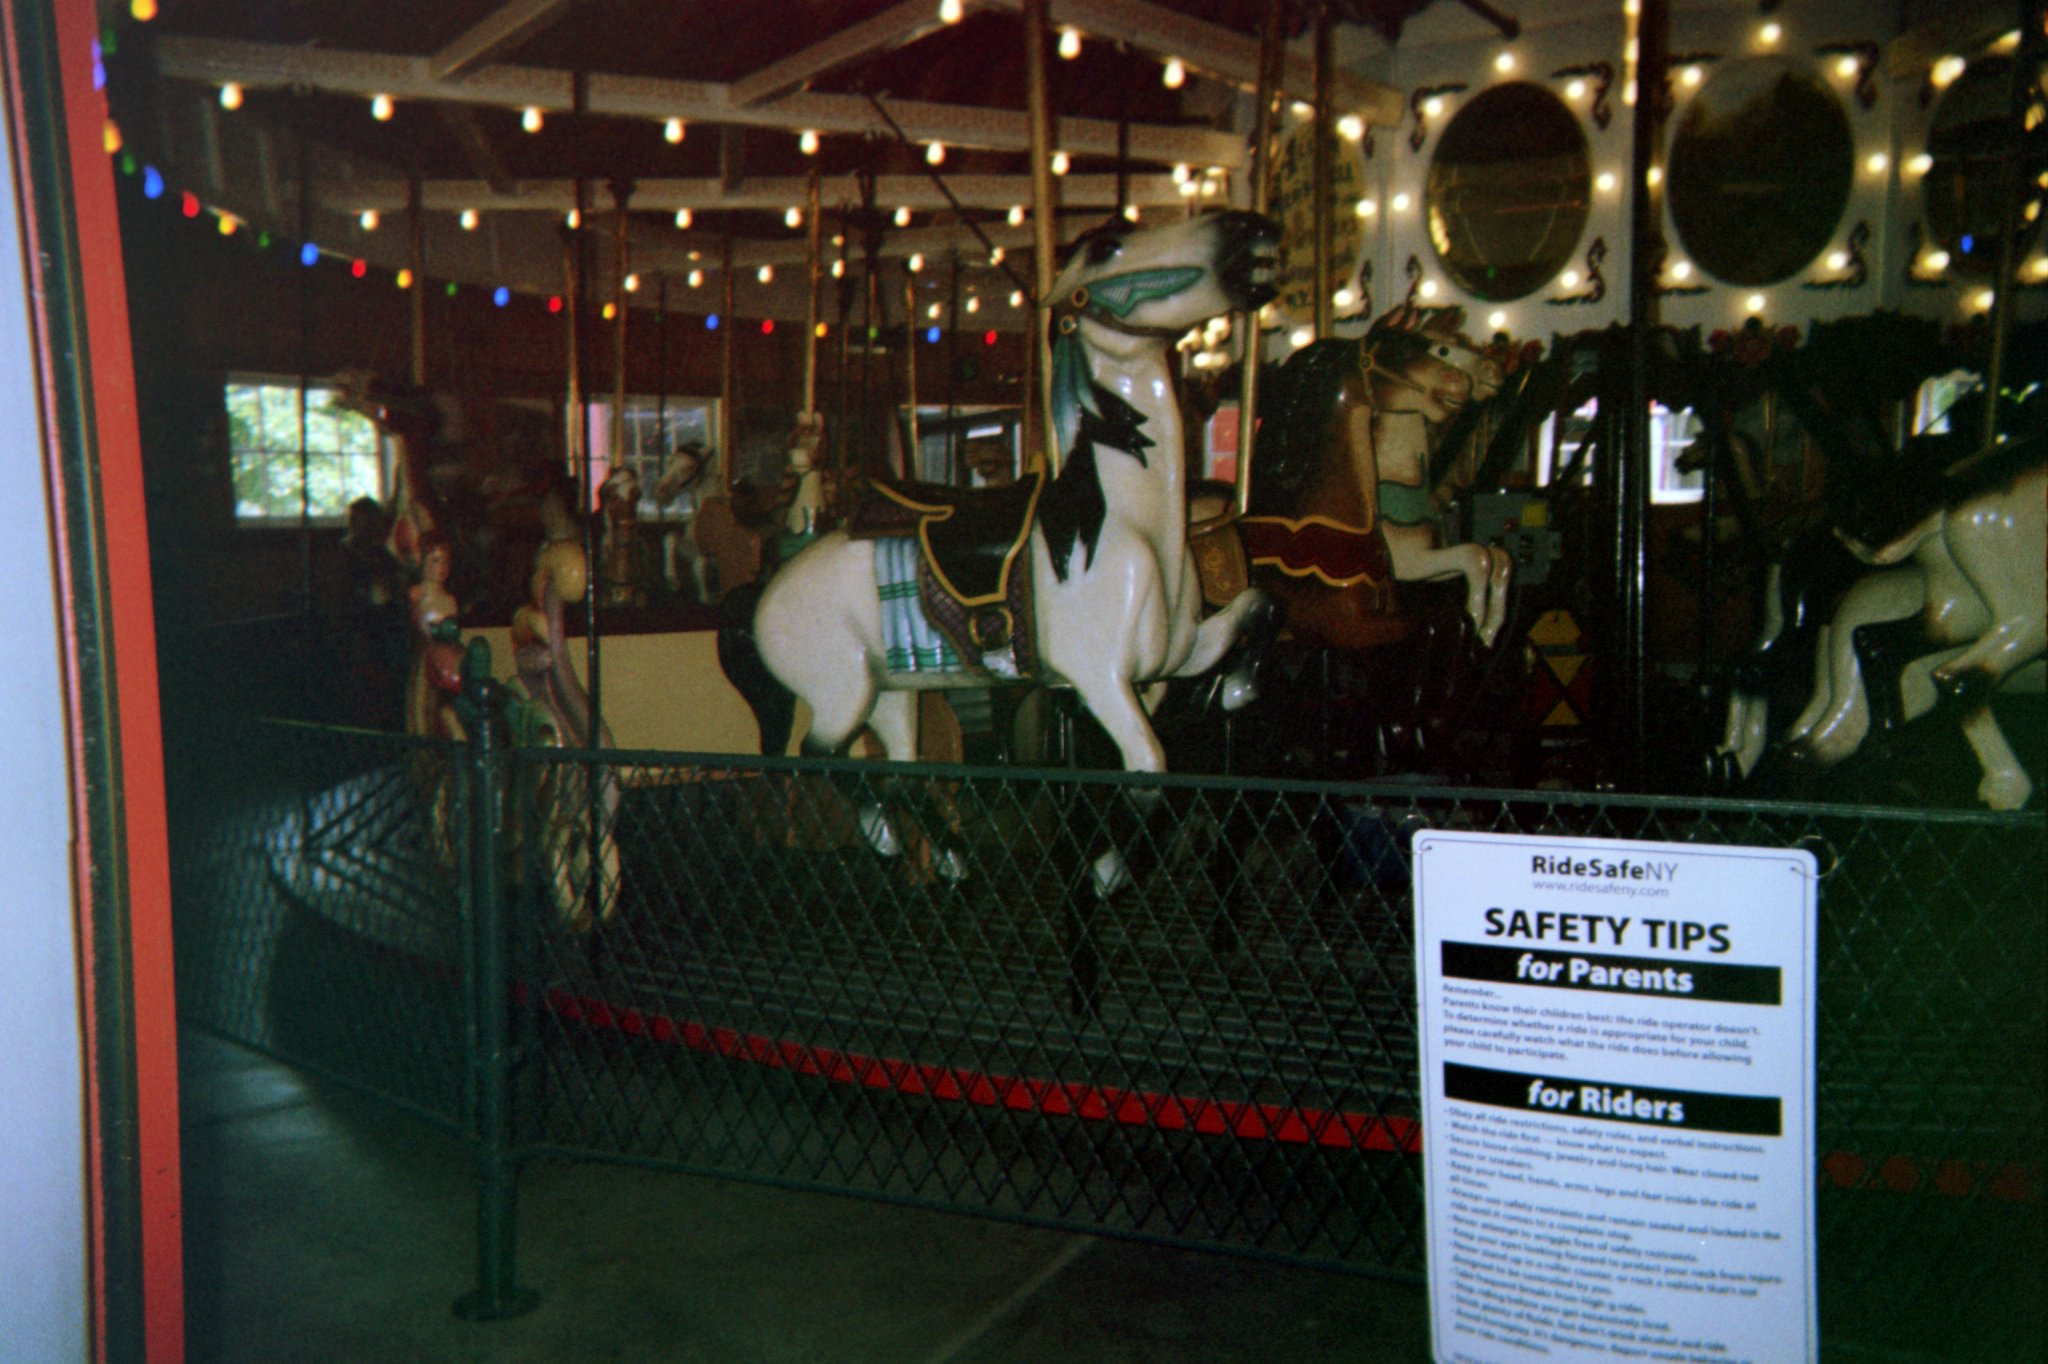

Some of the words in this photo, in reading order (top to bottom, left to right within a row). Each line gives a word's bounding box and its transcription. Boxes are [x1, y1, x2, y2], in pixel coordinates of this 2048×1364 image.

[1532, 855, 1679, 882] RideSafeNY
[1532, 879, 1670, 898] www.ridesafeny.com
[1485, 907, 1631, 946] SAFETY
[1642, 918, 1732, 954] TIPS
[1517, 953, 1564, 981] for
[1569, 957, 1695, 993] Parents
[1442, 996, 1479, 1009] Parents
[1482, 1001, 1509, 1012] know
[1512, 1004, 1537, 1015] their
[1540, 1007, 1583, 1019] children
[1616, 1013, 1634, 1024] the
[1637, 1015, 1658, 1026] ride
[1661, 1018, 1711, 1033] operator
[1714, 1022, 1759, 1035] doesn't.
[1443, 1009, 1454, 1018] To
[1456, 1010, 1507, 1025] determine
[1511, 1017, 1554, 1030] whether
[1566, 1023, 1587, 1033] ride
[1590, 1025, 1598, 1034] is
[1601, 1026, 1667, 1043] appropriate
[1670, 1032, 1685, 1042] for
[1689, 1036, 1714, 1047] your
[1443, 1023, 1473, 1037] please
[1476, 1027, 1520, 1042] carefully
[1524, 1032, 1554, 1044] watch
[1558, 1036, 1584, 1047] what
[1587, 1039, 1603, 1049] the
[1607, 1041, 1627, 1051] ride
[1632, 1043, 1658, 1055] does
[1662, 1046, 1698, 1058] before
[1701, 1050, 1751, 1065] allowing
[1443, 1038, 1464, 1049] your
[1467, 1039, 1491, 1050] child
[1495, 1042, 1504, 1052] to
[1528, 1079, 1574, 1109] for
[1580, 1086, 1685, 1122] Riders
